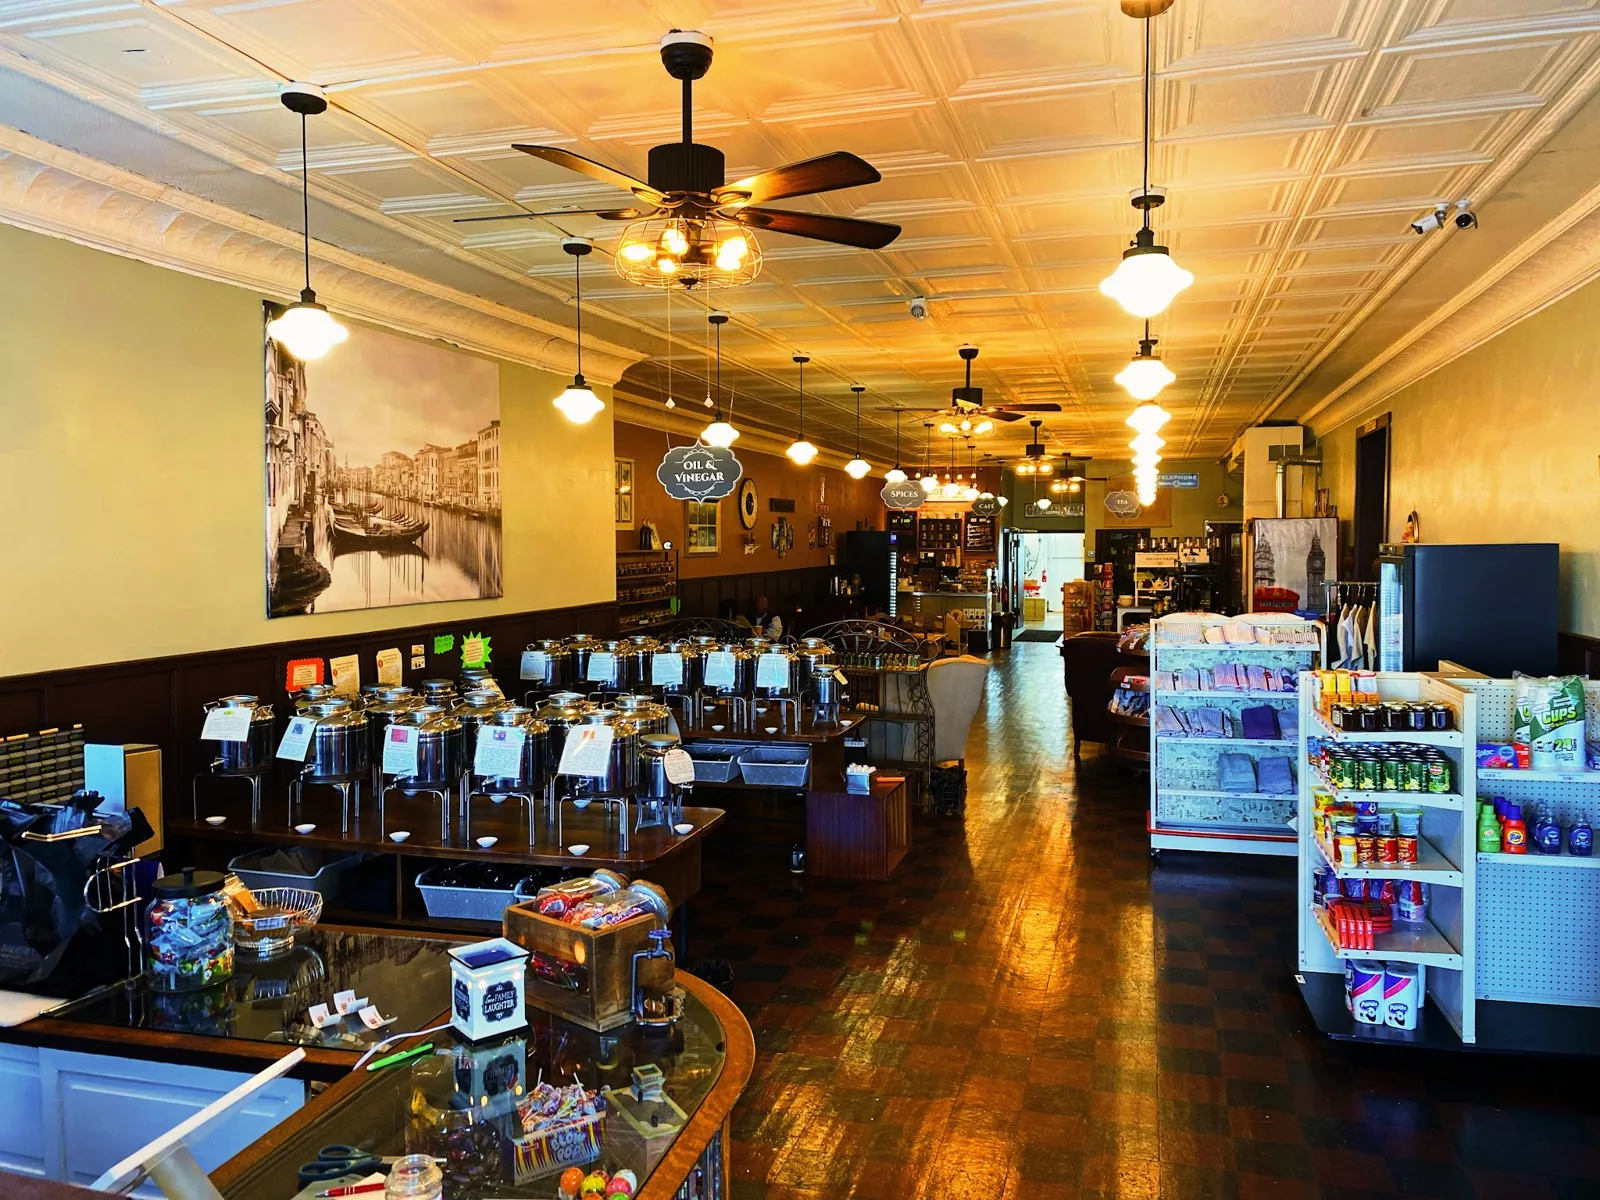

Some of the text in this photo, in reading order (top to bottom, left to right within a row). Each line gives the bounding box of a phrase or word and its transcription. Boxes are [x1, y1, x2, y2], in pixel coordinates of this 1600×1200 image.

[683, 459, 718, 470] OIL &
[674, 471, 725, 483] VINEGAR
[890, 490, 919, 498] SPICES
[1542, 706, 1578, 724] CUPS
[1554, 738, 1573, 752] 24
[1476, 748, 1495, 758] iploc
[494, 989, 515, 1002] FAMILY
[484, 998, 515, 1013] LAUGHTER
[550, 1130, 586, 1151] BLOW
